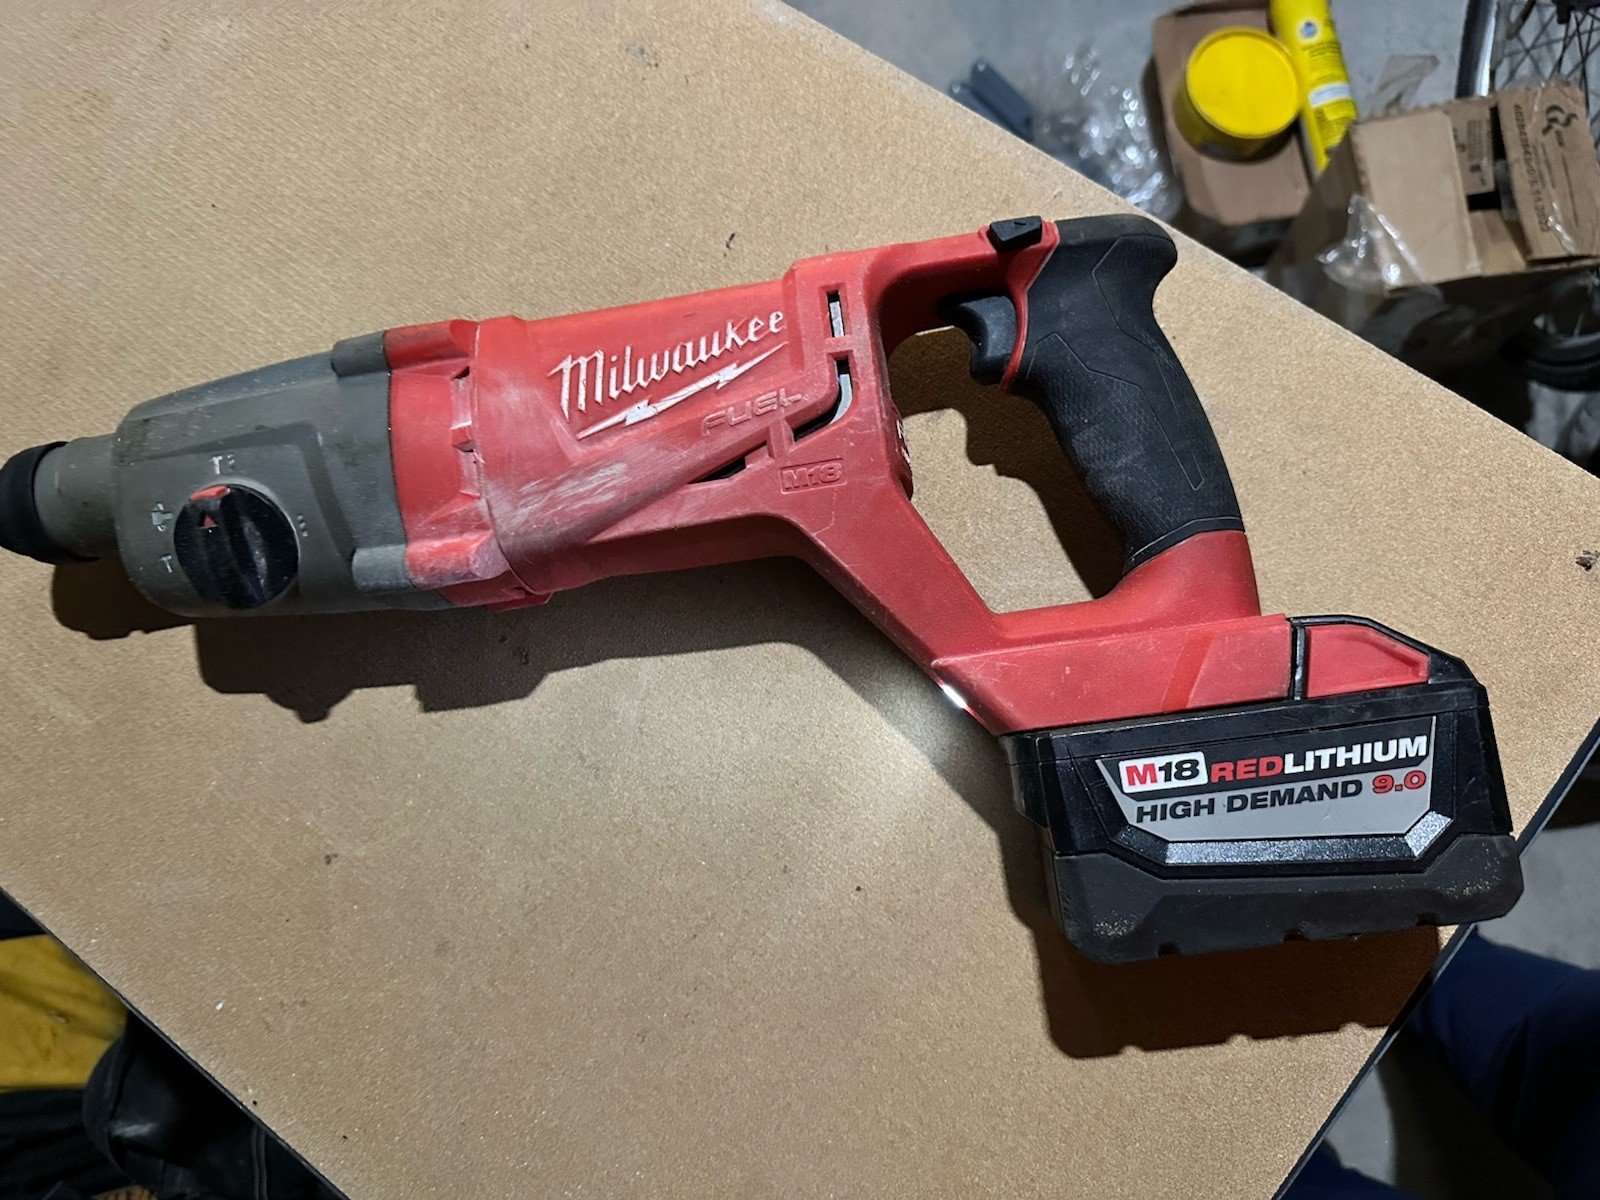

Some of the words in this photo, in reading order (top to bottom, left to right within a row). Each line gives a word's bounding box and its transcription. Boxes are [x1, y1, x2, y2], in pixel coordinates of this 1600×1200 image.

[547, 310, 784, 422] Milwaukee
[702, 387, 802, 437] FUEL
[782, 462, 843, 490] M18
[1125, 759, 1200, 787] M18
[1210, 735, 1428, 783] REDLITHIUM
[1135, 797, 1215, 824] HIGH
[1226, 778, 1363, 813] DEMAND
[1371, 769, 1428, 794] 9.0
